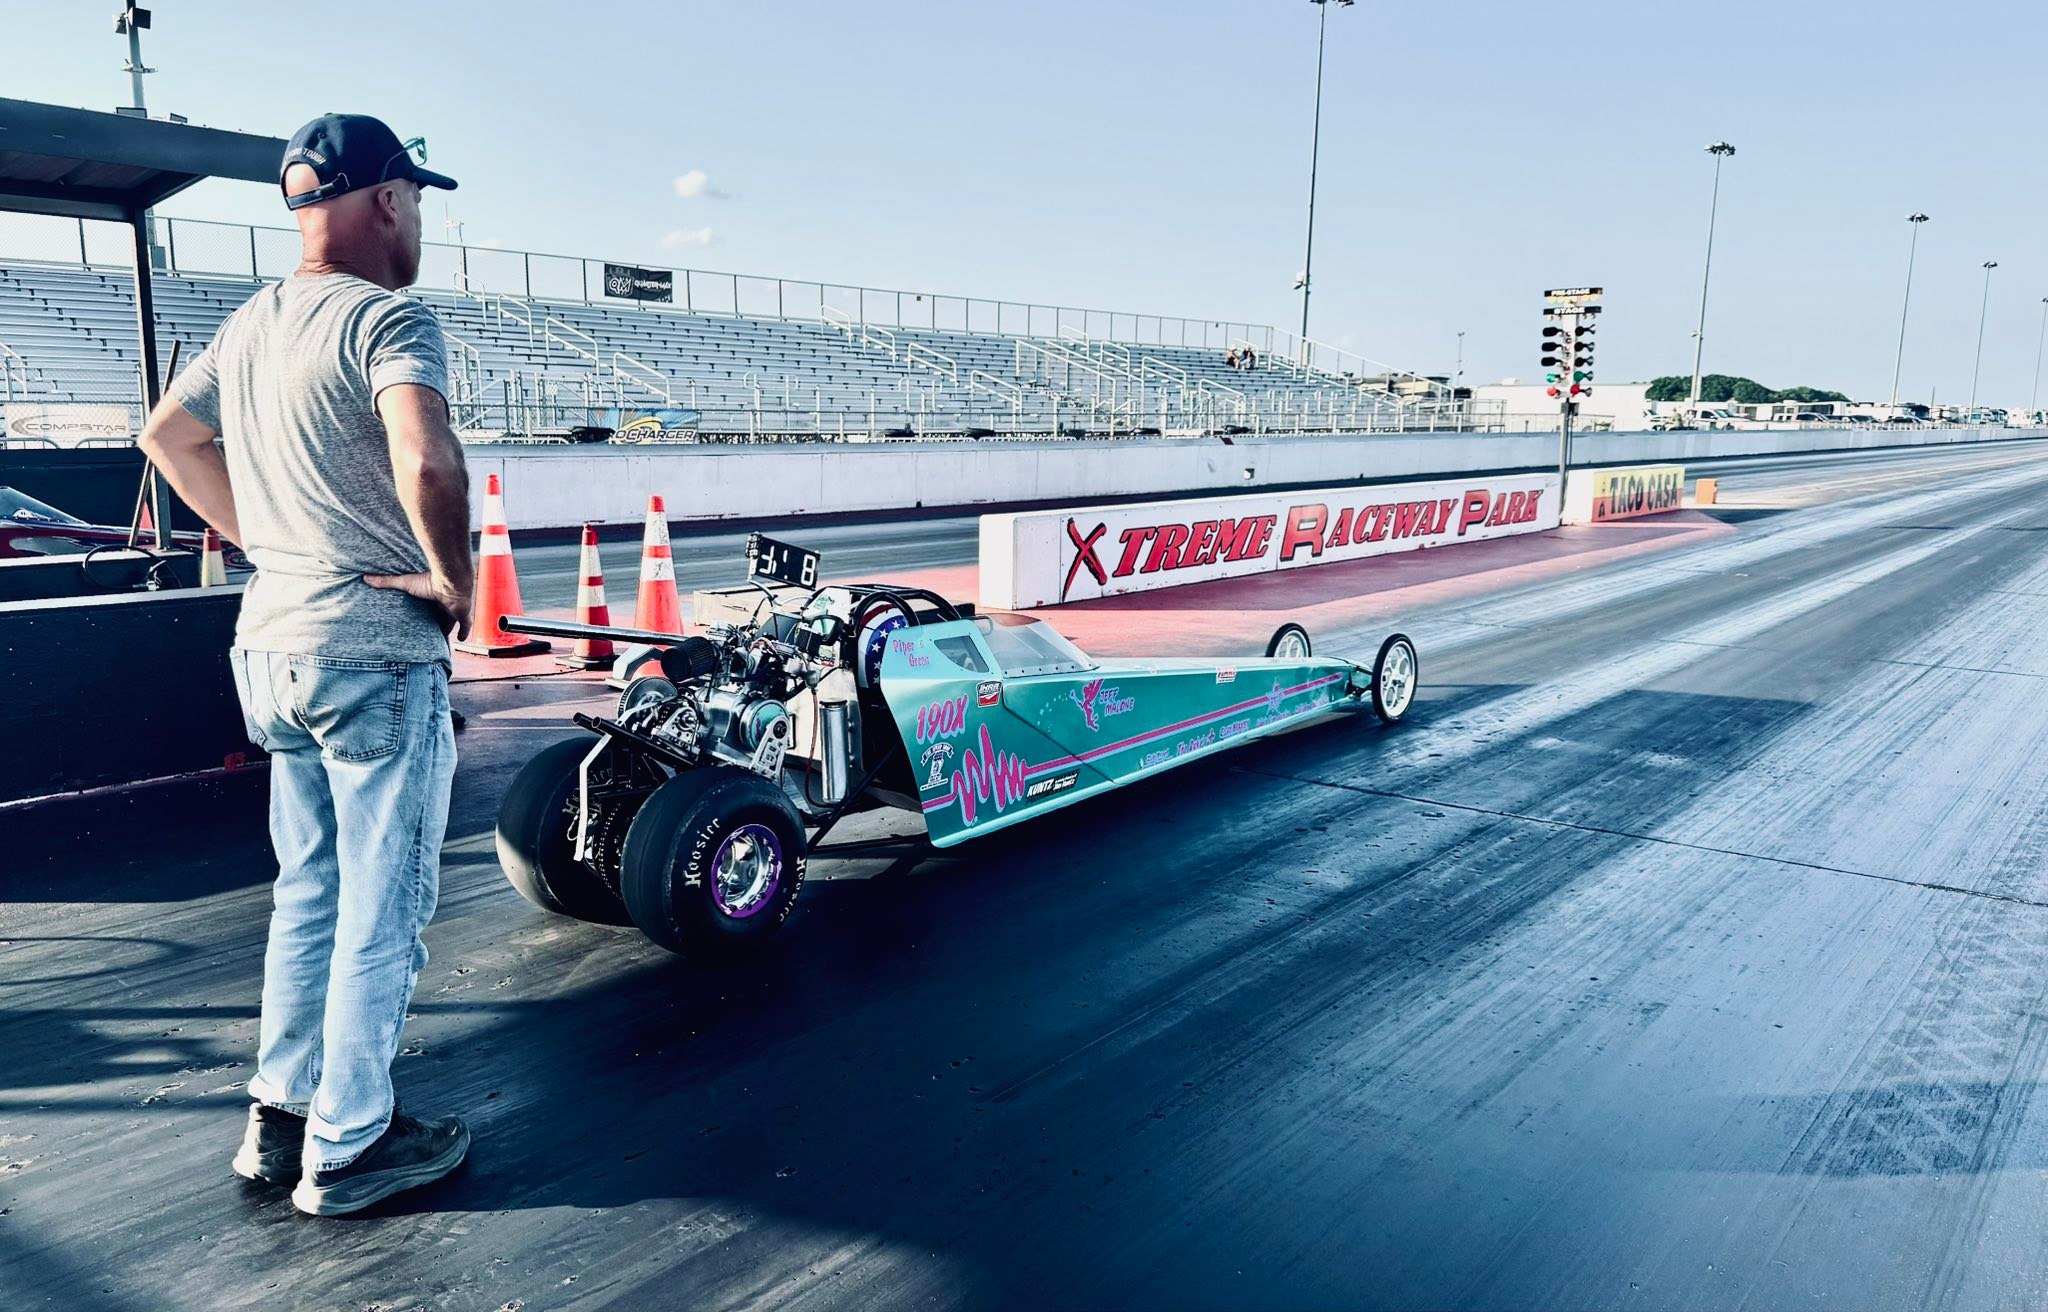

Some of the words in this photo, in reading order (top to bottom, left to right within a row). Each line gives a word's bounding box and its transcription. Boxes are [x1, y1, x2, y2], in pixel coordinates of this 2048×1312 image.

[302, 147, 327, 165] TOUGH
[1554, 306, 1586, 315] STAGE
[26, 423, 126, 432] COMPSTAR
[611, 428, 694, 441] OCHARGER
[1610, 475, 1645, 514] TACO
[1647, 473, 1679, 511] CASA
[1280, 503, 1458, 561] RACEWAY
[1457, 489, 1544, 536] PARK
[892, 639, 914, 656] Piper
[1099, 686, 1120, 704] JEFF
[1104, 697, 1135, 717] MALONE
[917, 694, 968, 744] 190X
[1026, 778, 1055, 797] KUNTZ
[682, 817, 721, 889] Hoosier
